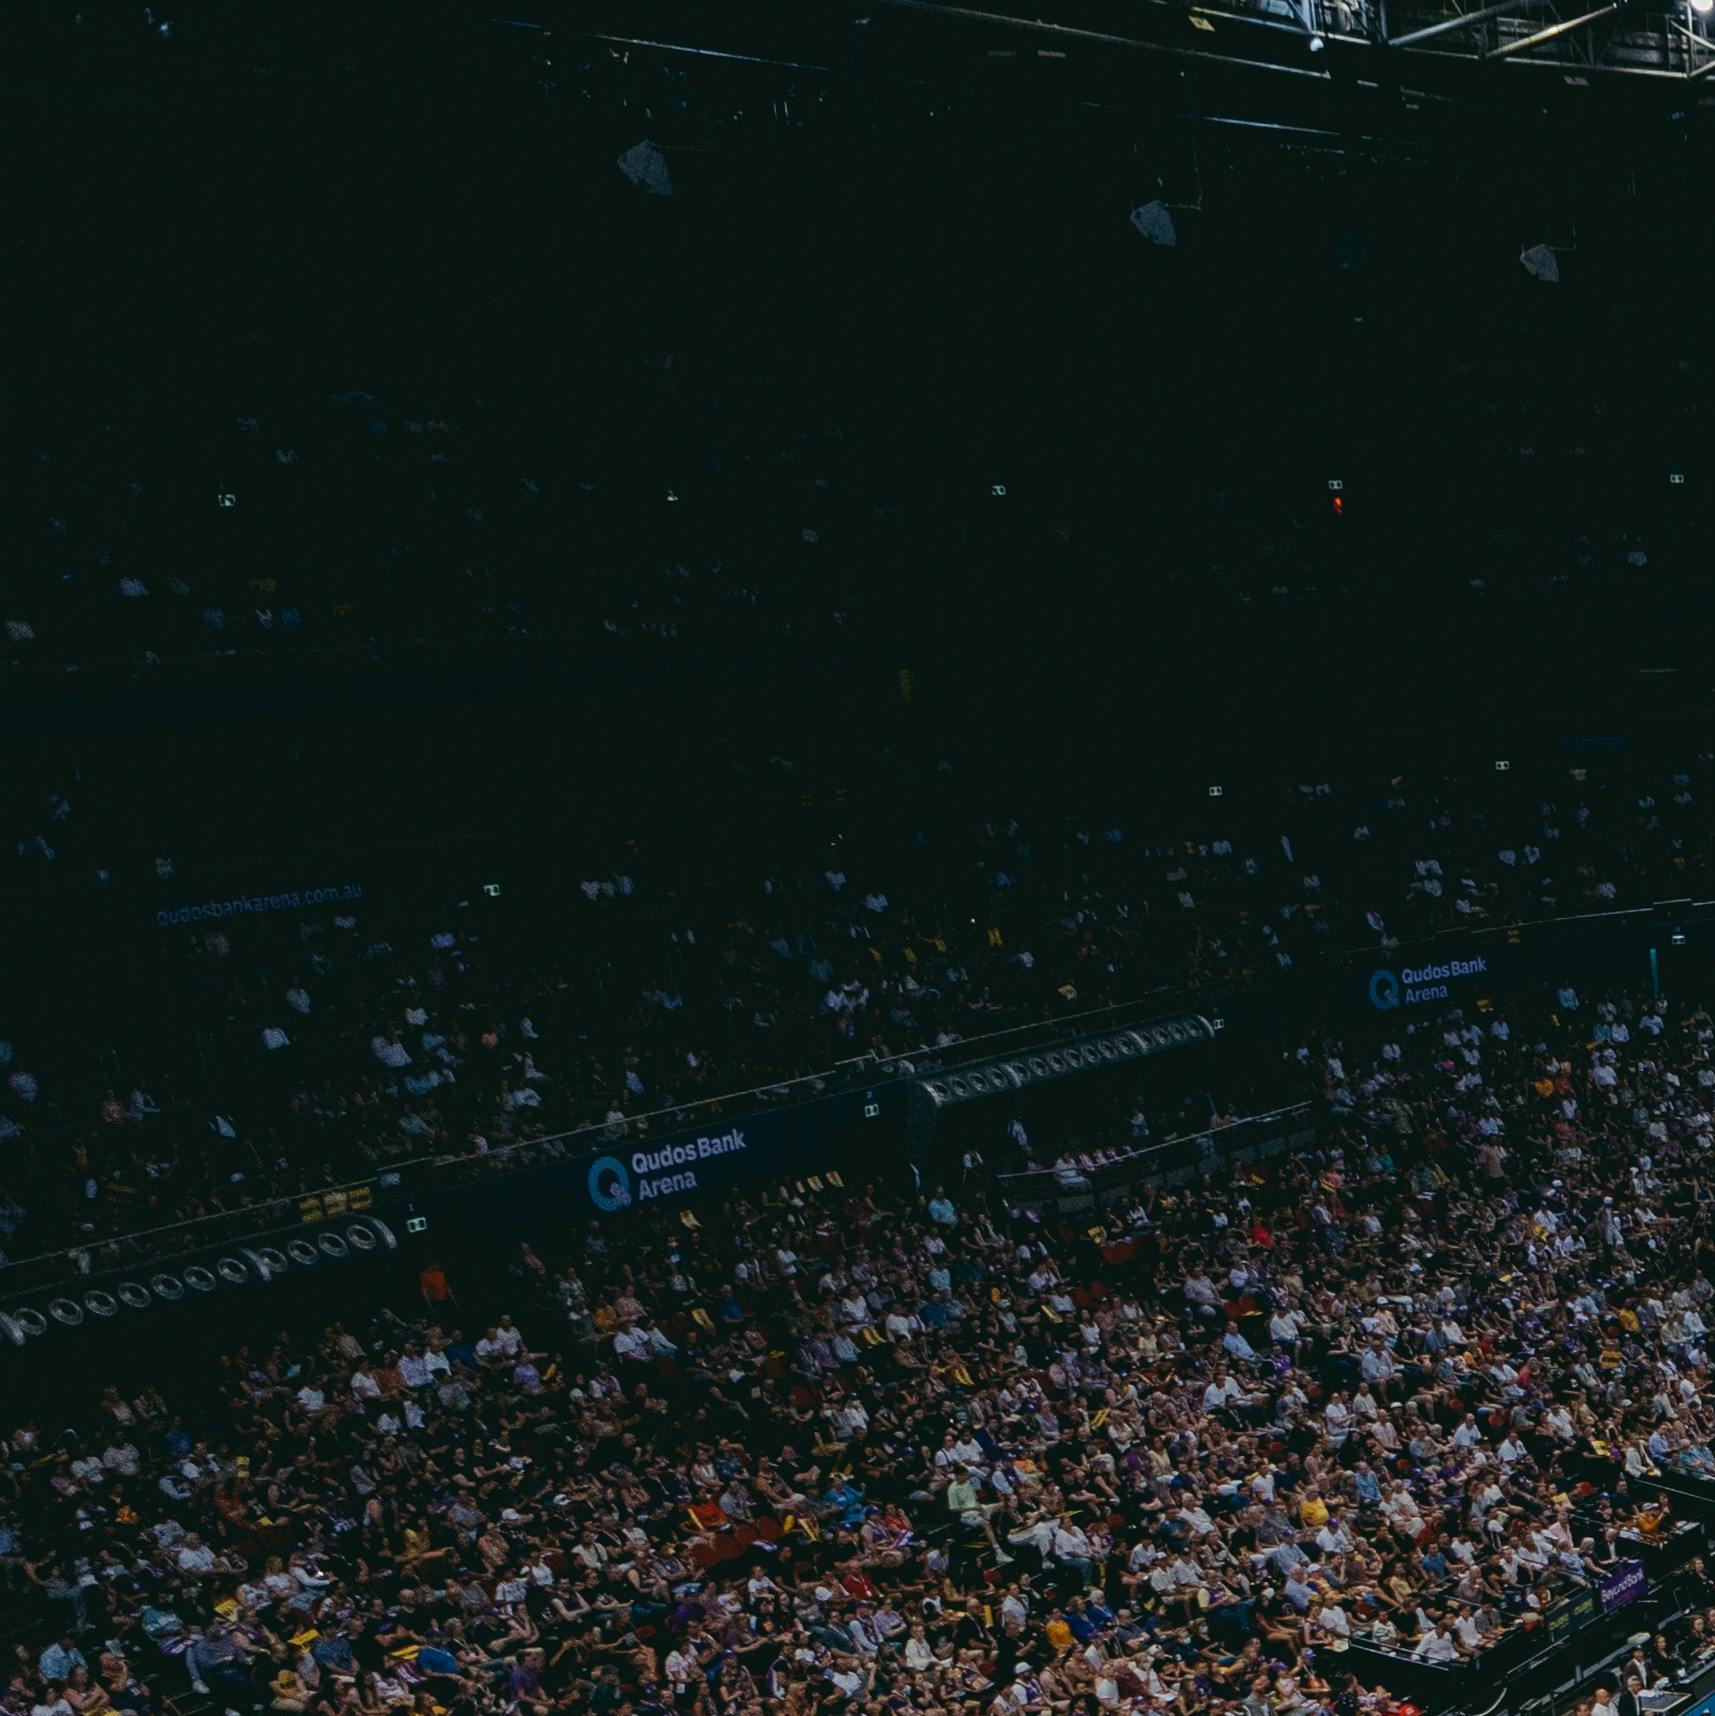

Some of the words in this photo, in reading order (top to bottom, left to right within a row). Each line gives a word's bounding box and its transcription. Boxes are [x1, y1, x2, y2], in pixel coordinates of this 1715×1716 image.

[1402, 963, 1450, 984] Qudos
[1450, 955, 1488, 976] Bank
[1405, 984, 1449, 1004] Arena
[632, 1143, 697, 1174] Qudos
[696, 1128, 748, 1159] Bank
[639, 1171, 698, 1200] Arena
